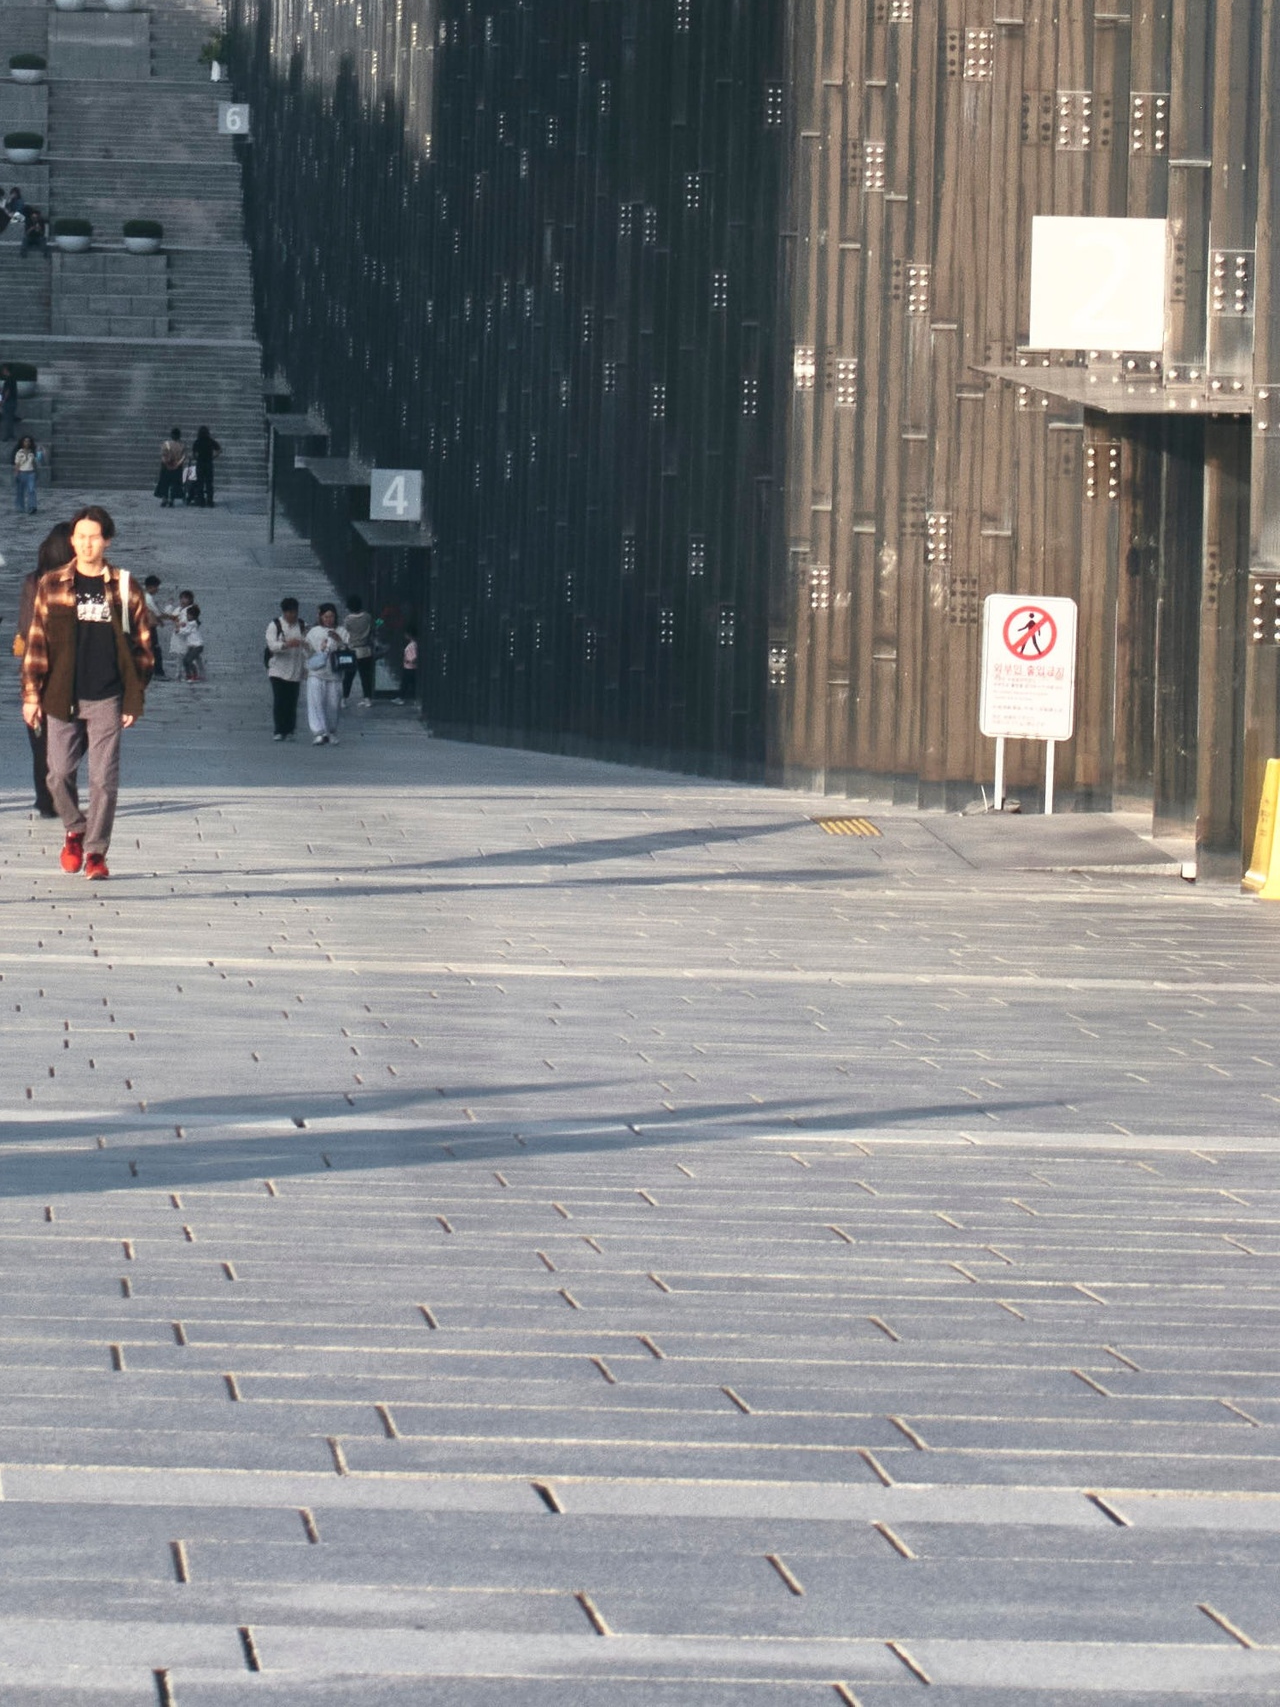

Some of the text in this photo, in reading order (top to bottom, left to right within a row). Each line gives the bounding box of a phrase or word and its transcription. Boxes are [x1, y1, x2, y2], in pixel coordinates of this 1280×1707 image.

[226, 107, 241, 131] 6
[1069, 232, 1132, 332] 2
[382, 475, 408, 515] 4
[993, 663, 1022, 675] 외부인
[1027, 665, 1064, 679] 출입금지
